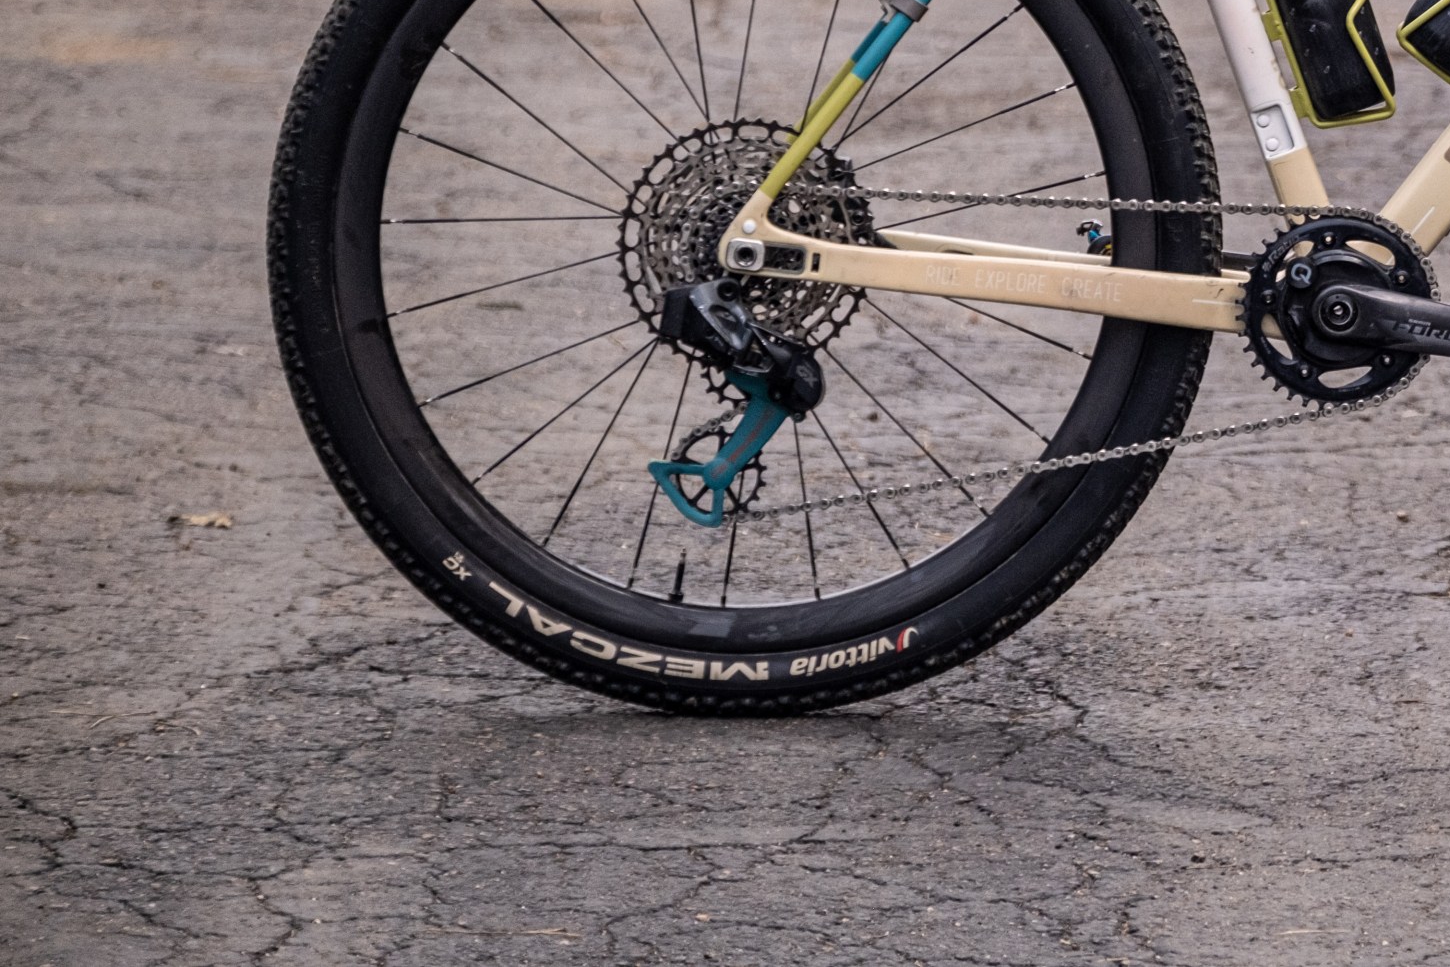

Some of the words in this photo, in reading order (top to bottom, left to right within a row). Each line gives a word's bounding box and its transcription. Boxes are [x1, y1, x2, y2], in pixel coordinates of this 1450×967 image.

[926, 265, 961, 288] RIDE
[975, 269, 1046, 295] EXPLORE
[1062, 277, 1123, 303] CREATE
[1291, 263, 1311, 285] Q
[488, 581, 770, 681] MEZCAL
[789, 636, 896, 677] vittoria
